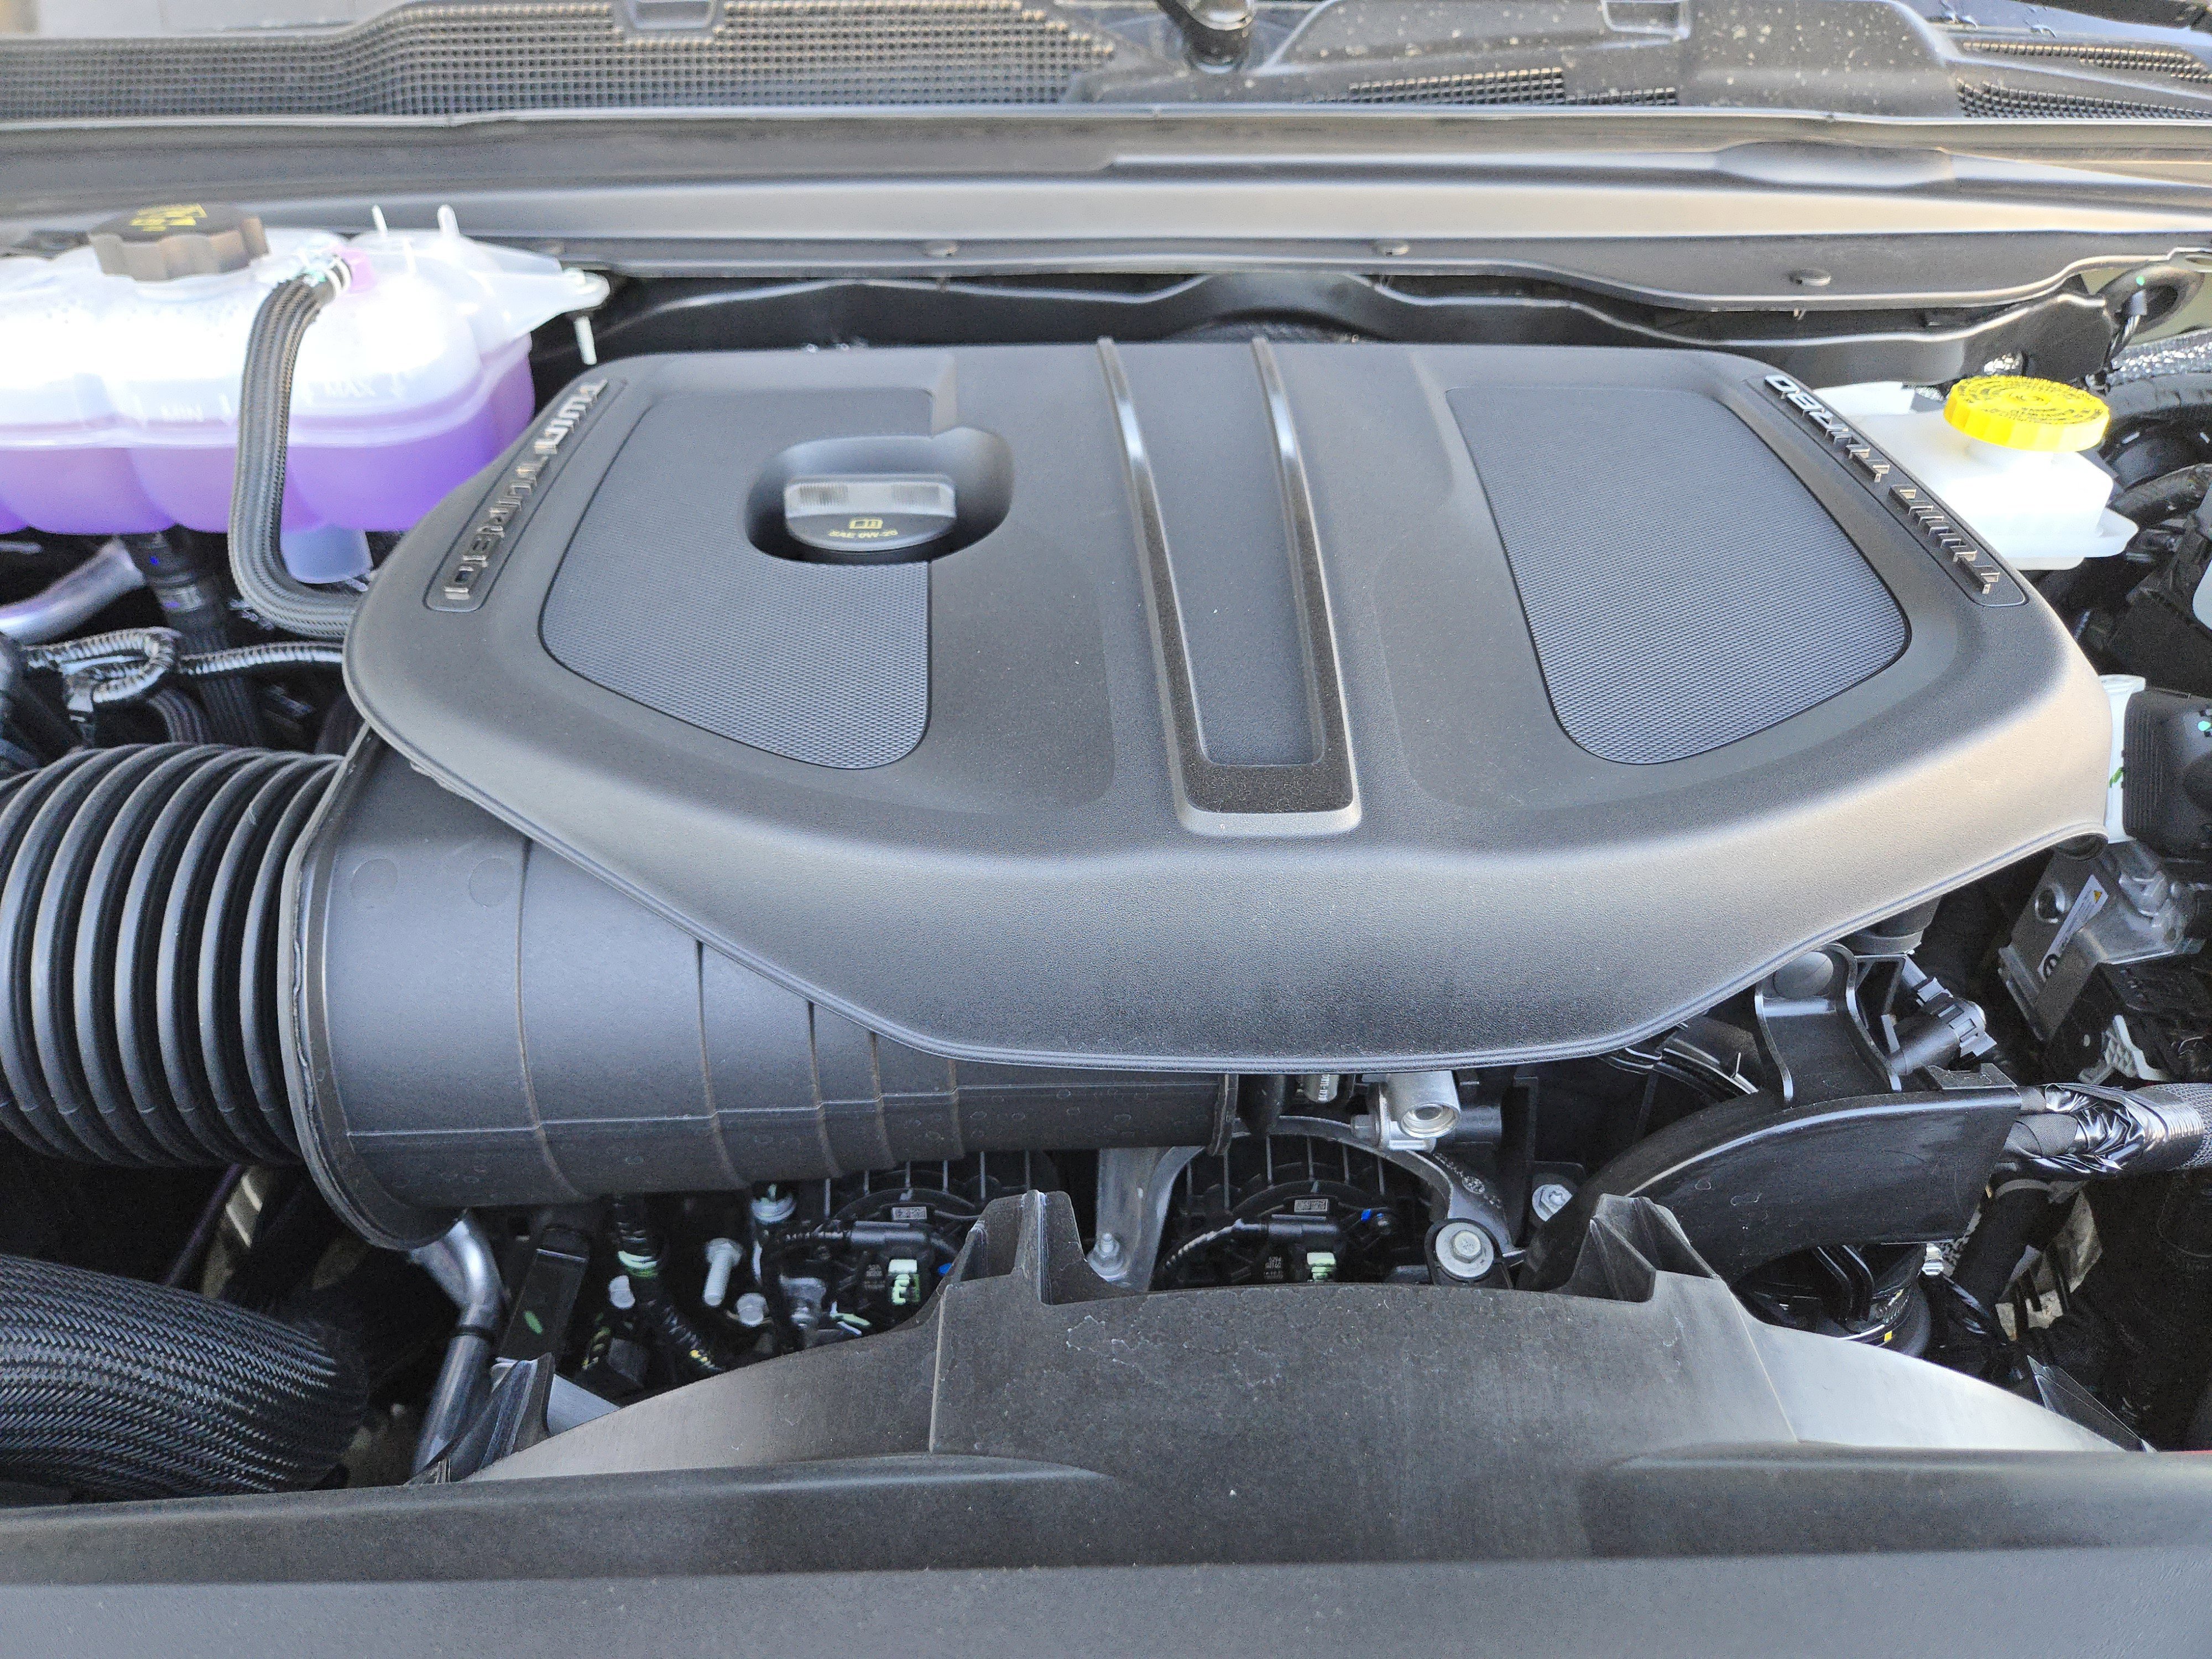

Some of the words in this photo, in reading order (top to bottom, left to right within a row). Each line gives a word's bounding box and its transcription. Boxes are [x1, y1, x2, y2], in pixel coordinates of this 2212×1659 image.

[534, 379, 608, 455] TWIN
[1764, 374, 1890, 483] TURBO
[444, 456, 550, 601] TURBO
[1889, 484, 2000, 594] TWIN
